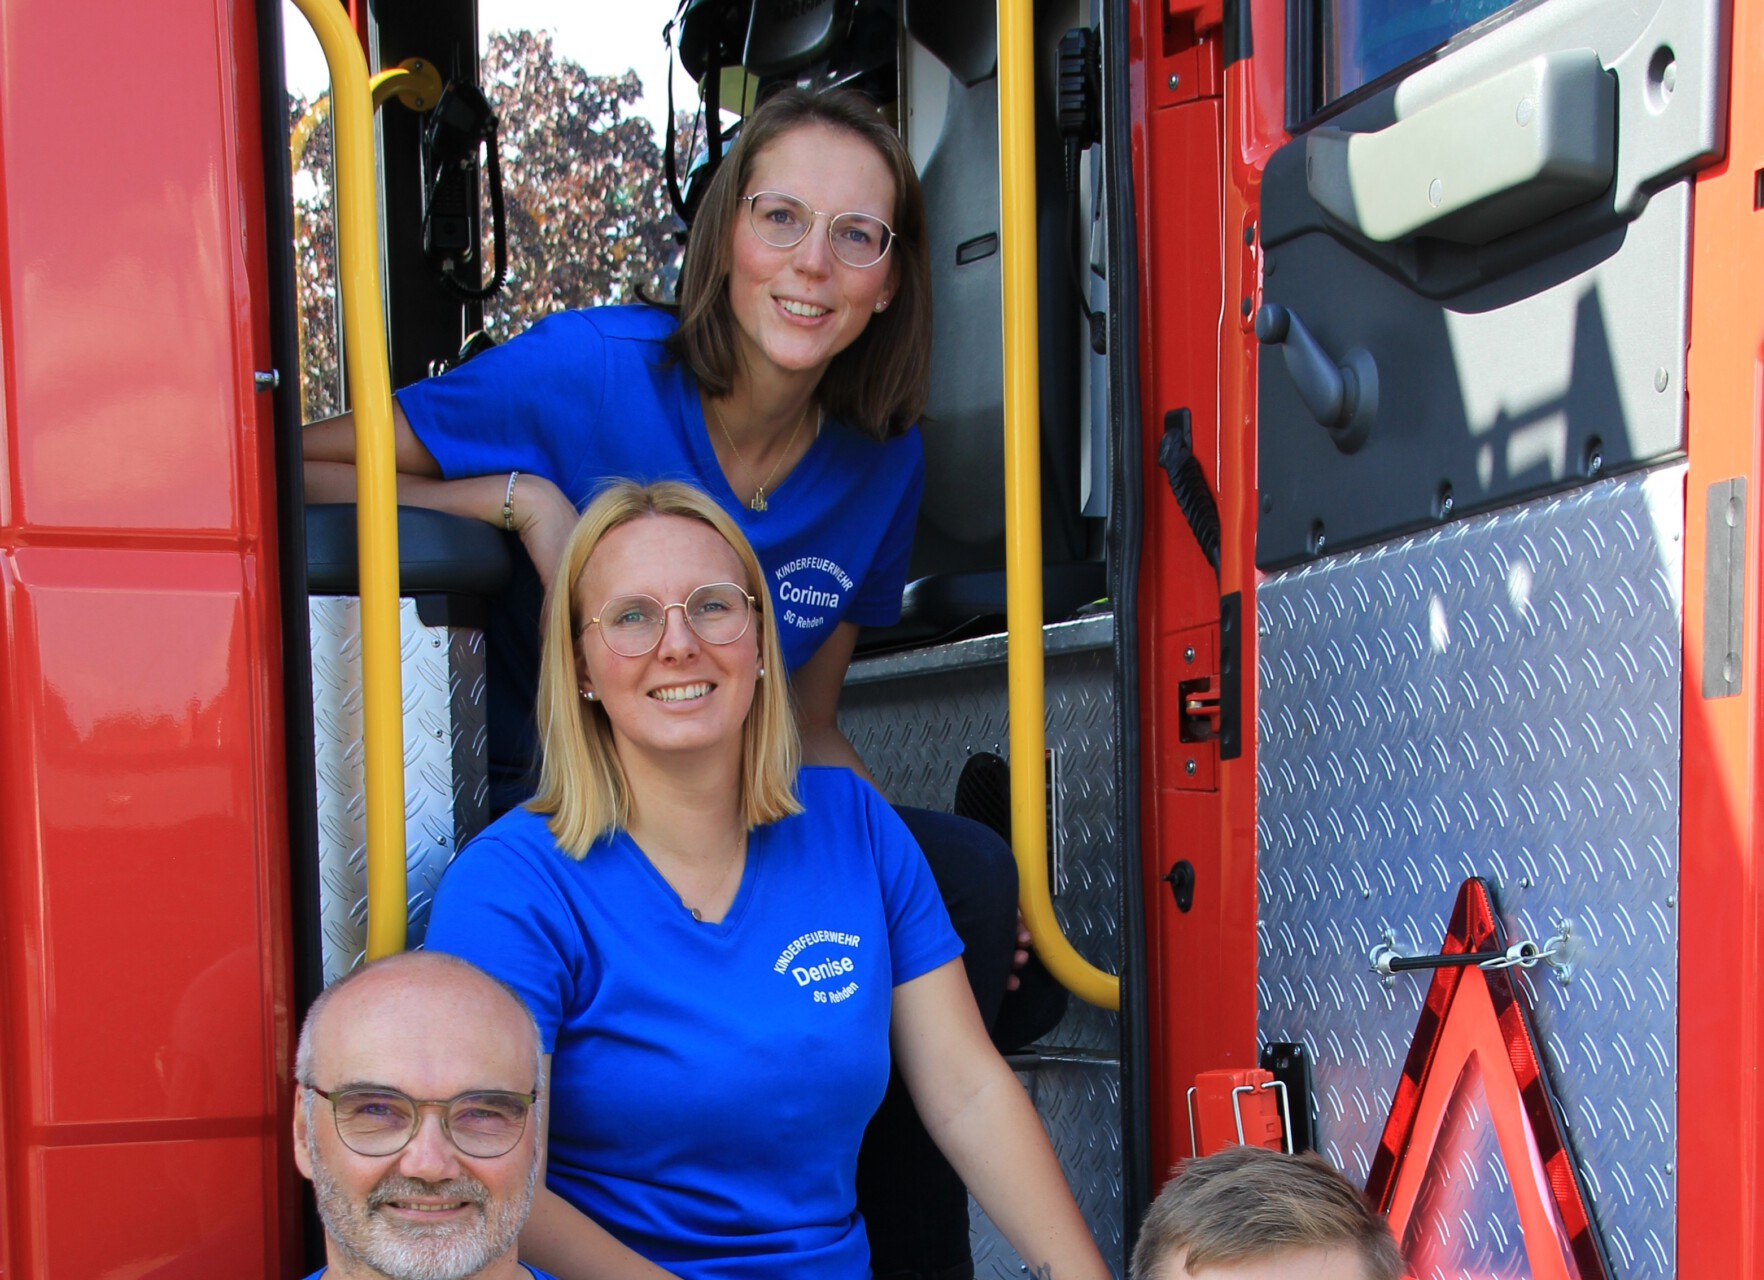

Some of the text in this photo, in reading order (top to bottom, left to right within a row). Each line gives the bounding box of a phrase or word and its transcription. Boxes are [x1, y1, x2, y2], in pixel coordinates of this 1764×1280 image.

[775, 557, 854, 592] KINDERFEUERWEHR
[779, 581, 839, 608] Corinna
[783, 609, 824, 629] SG Rehden
[773, 930, 861, 975] KINDERFEUERWEHR
[791, 956, 854, 987] Denise
[813, 981, 860, 1004] SG Rehden
